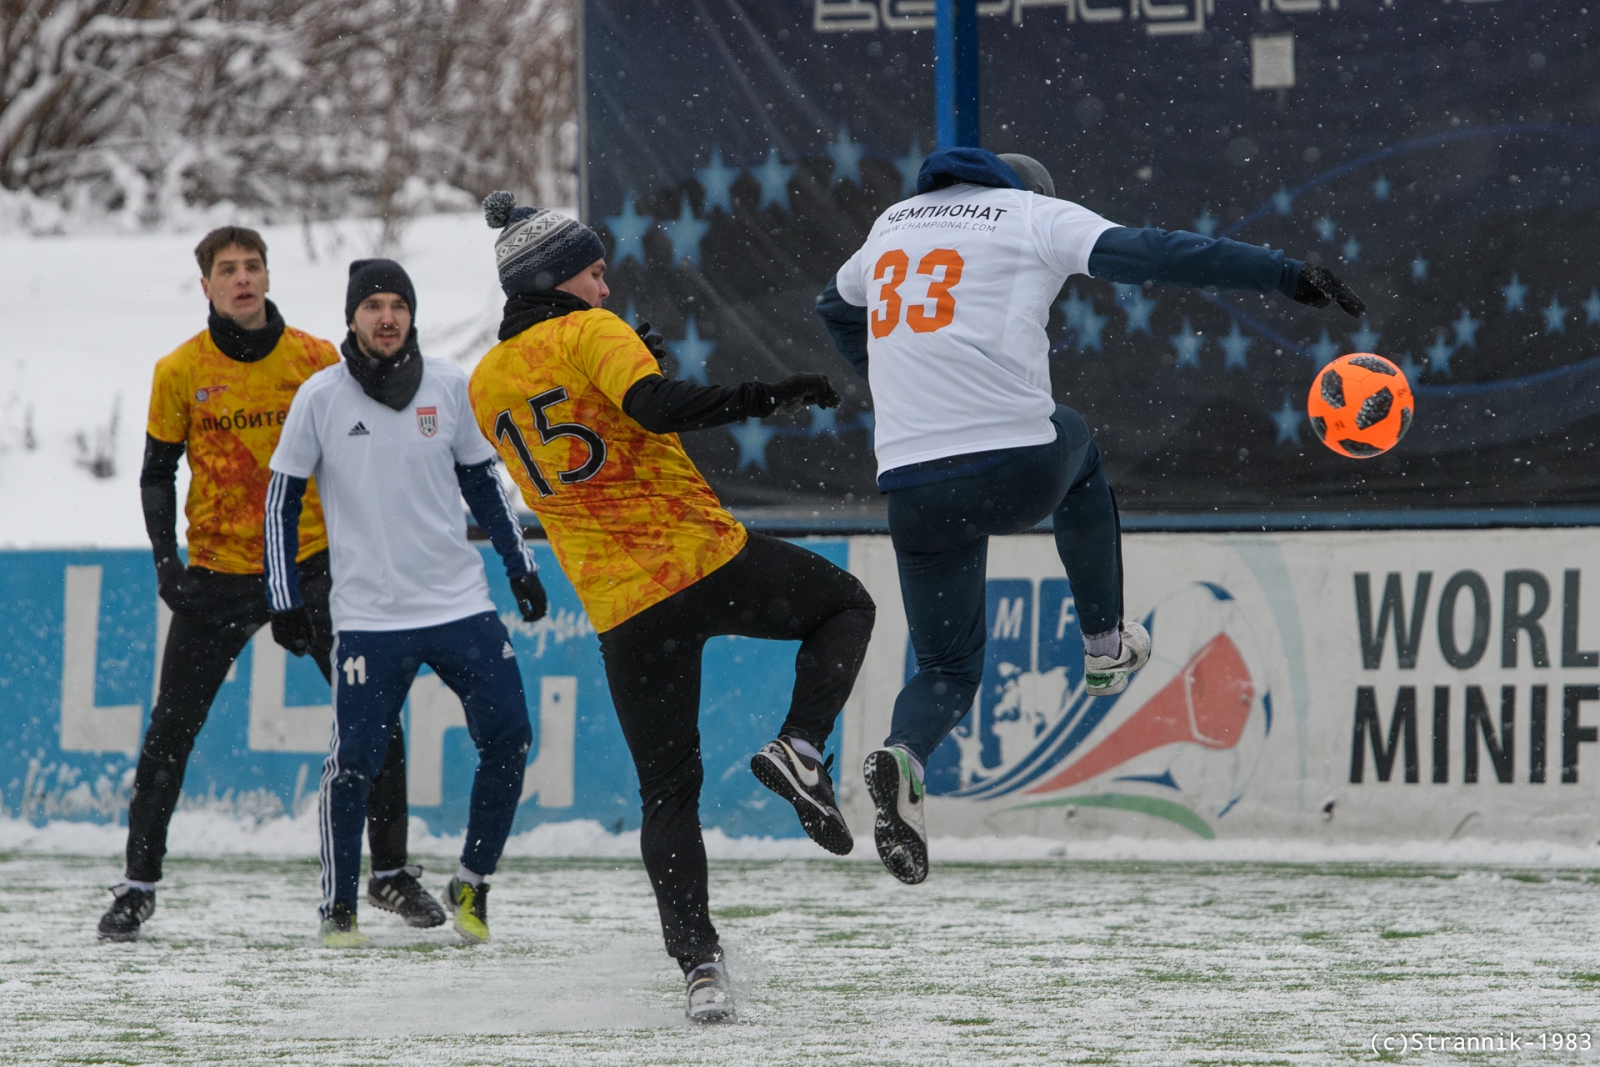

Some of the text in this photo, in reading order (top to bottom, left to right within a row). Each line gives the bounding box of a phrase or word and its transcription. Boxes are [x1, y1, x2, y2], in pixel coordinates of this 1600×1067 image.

[878, 220, 997, 238] WWW.CHAMPIONAT.COM
[888, 204, 1007, 224] ЧЕМПИОНАТ
[871, 248, 965, 339] 33
[494, 385, 607, 498] 15
[1352, 567, 1600, 670] WORL
[343, 655, 366, 686] 11
[1348, 683, 1600, 784] MINIF
